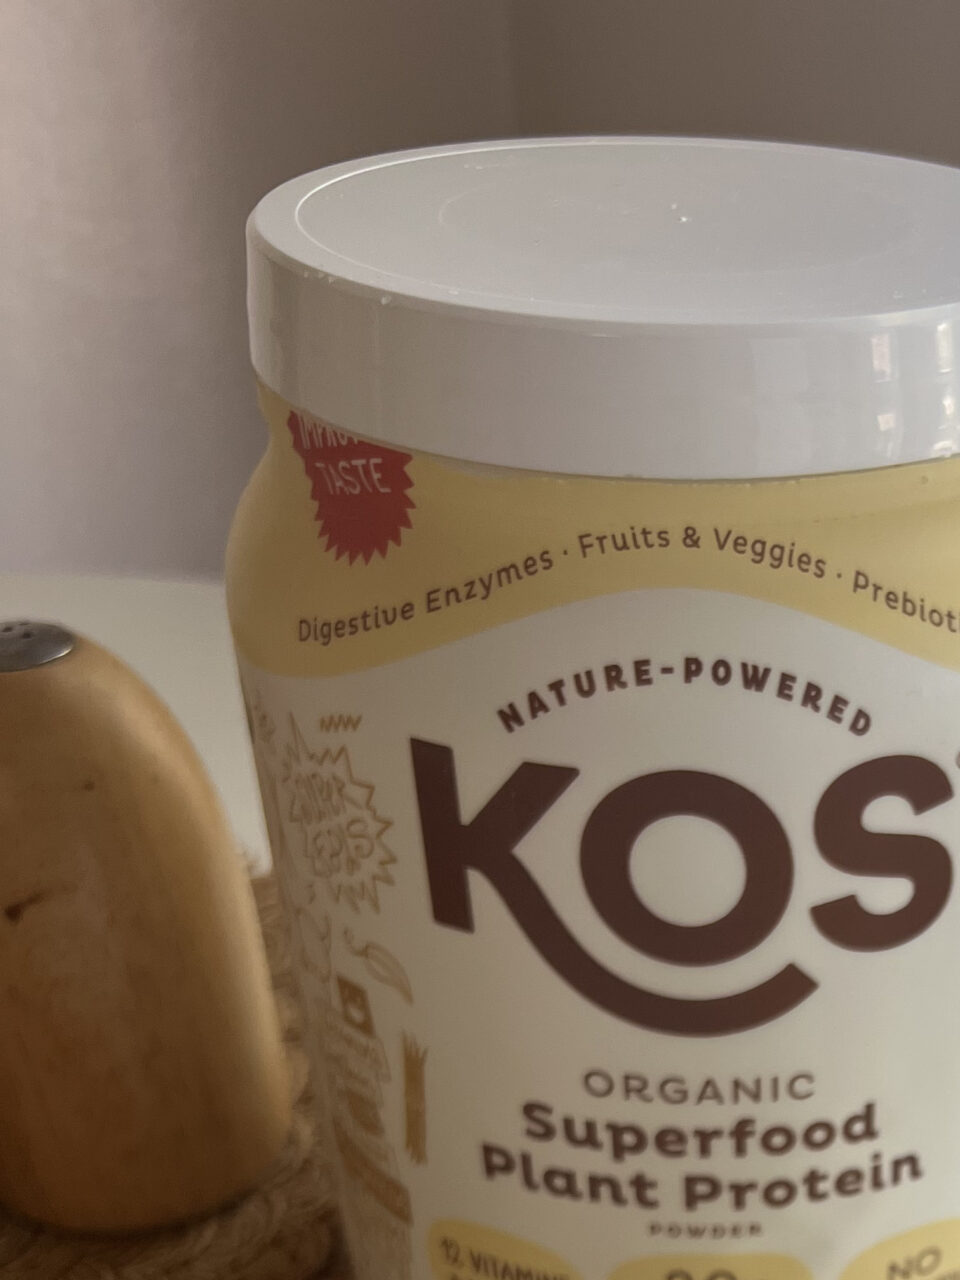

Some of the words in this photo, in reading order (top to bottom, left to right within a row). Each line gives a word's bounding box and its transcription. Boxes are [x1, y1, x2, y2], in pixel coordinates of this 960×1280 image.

[314, 457, 392, 495] TASTE
[298, 601, 415, 647] Digestive
[425, 548, 554, 613] Enzymes
[578, 526, 671, 558] Fruits
[682, 526, 701, 548] &
[713, 528, 827, 579] Veggies
[496, 656, 872, 737] NATURE-POWERED
[409, 737, 955, 1038] KOS
[582, 1069, 816, 1105] ORGANIC
[521, 1101, 878, 1164] Superfood
[481, 1143, 660, 1210] Plant
[683, 1151, 923, 1212] Protein
[439, 1236, 465, 1269] 12
[647, 1221, 763, 1239] POWDER
